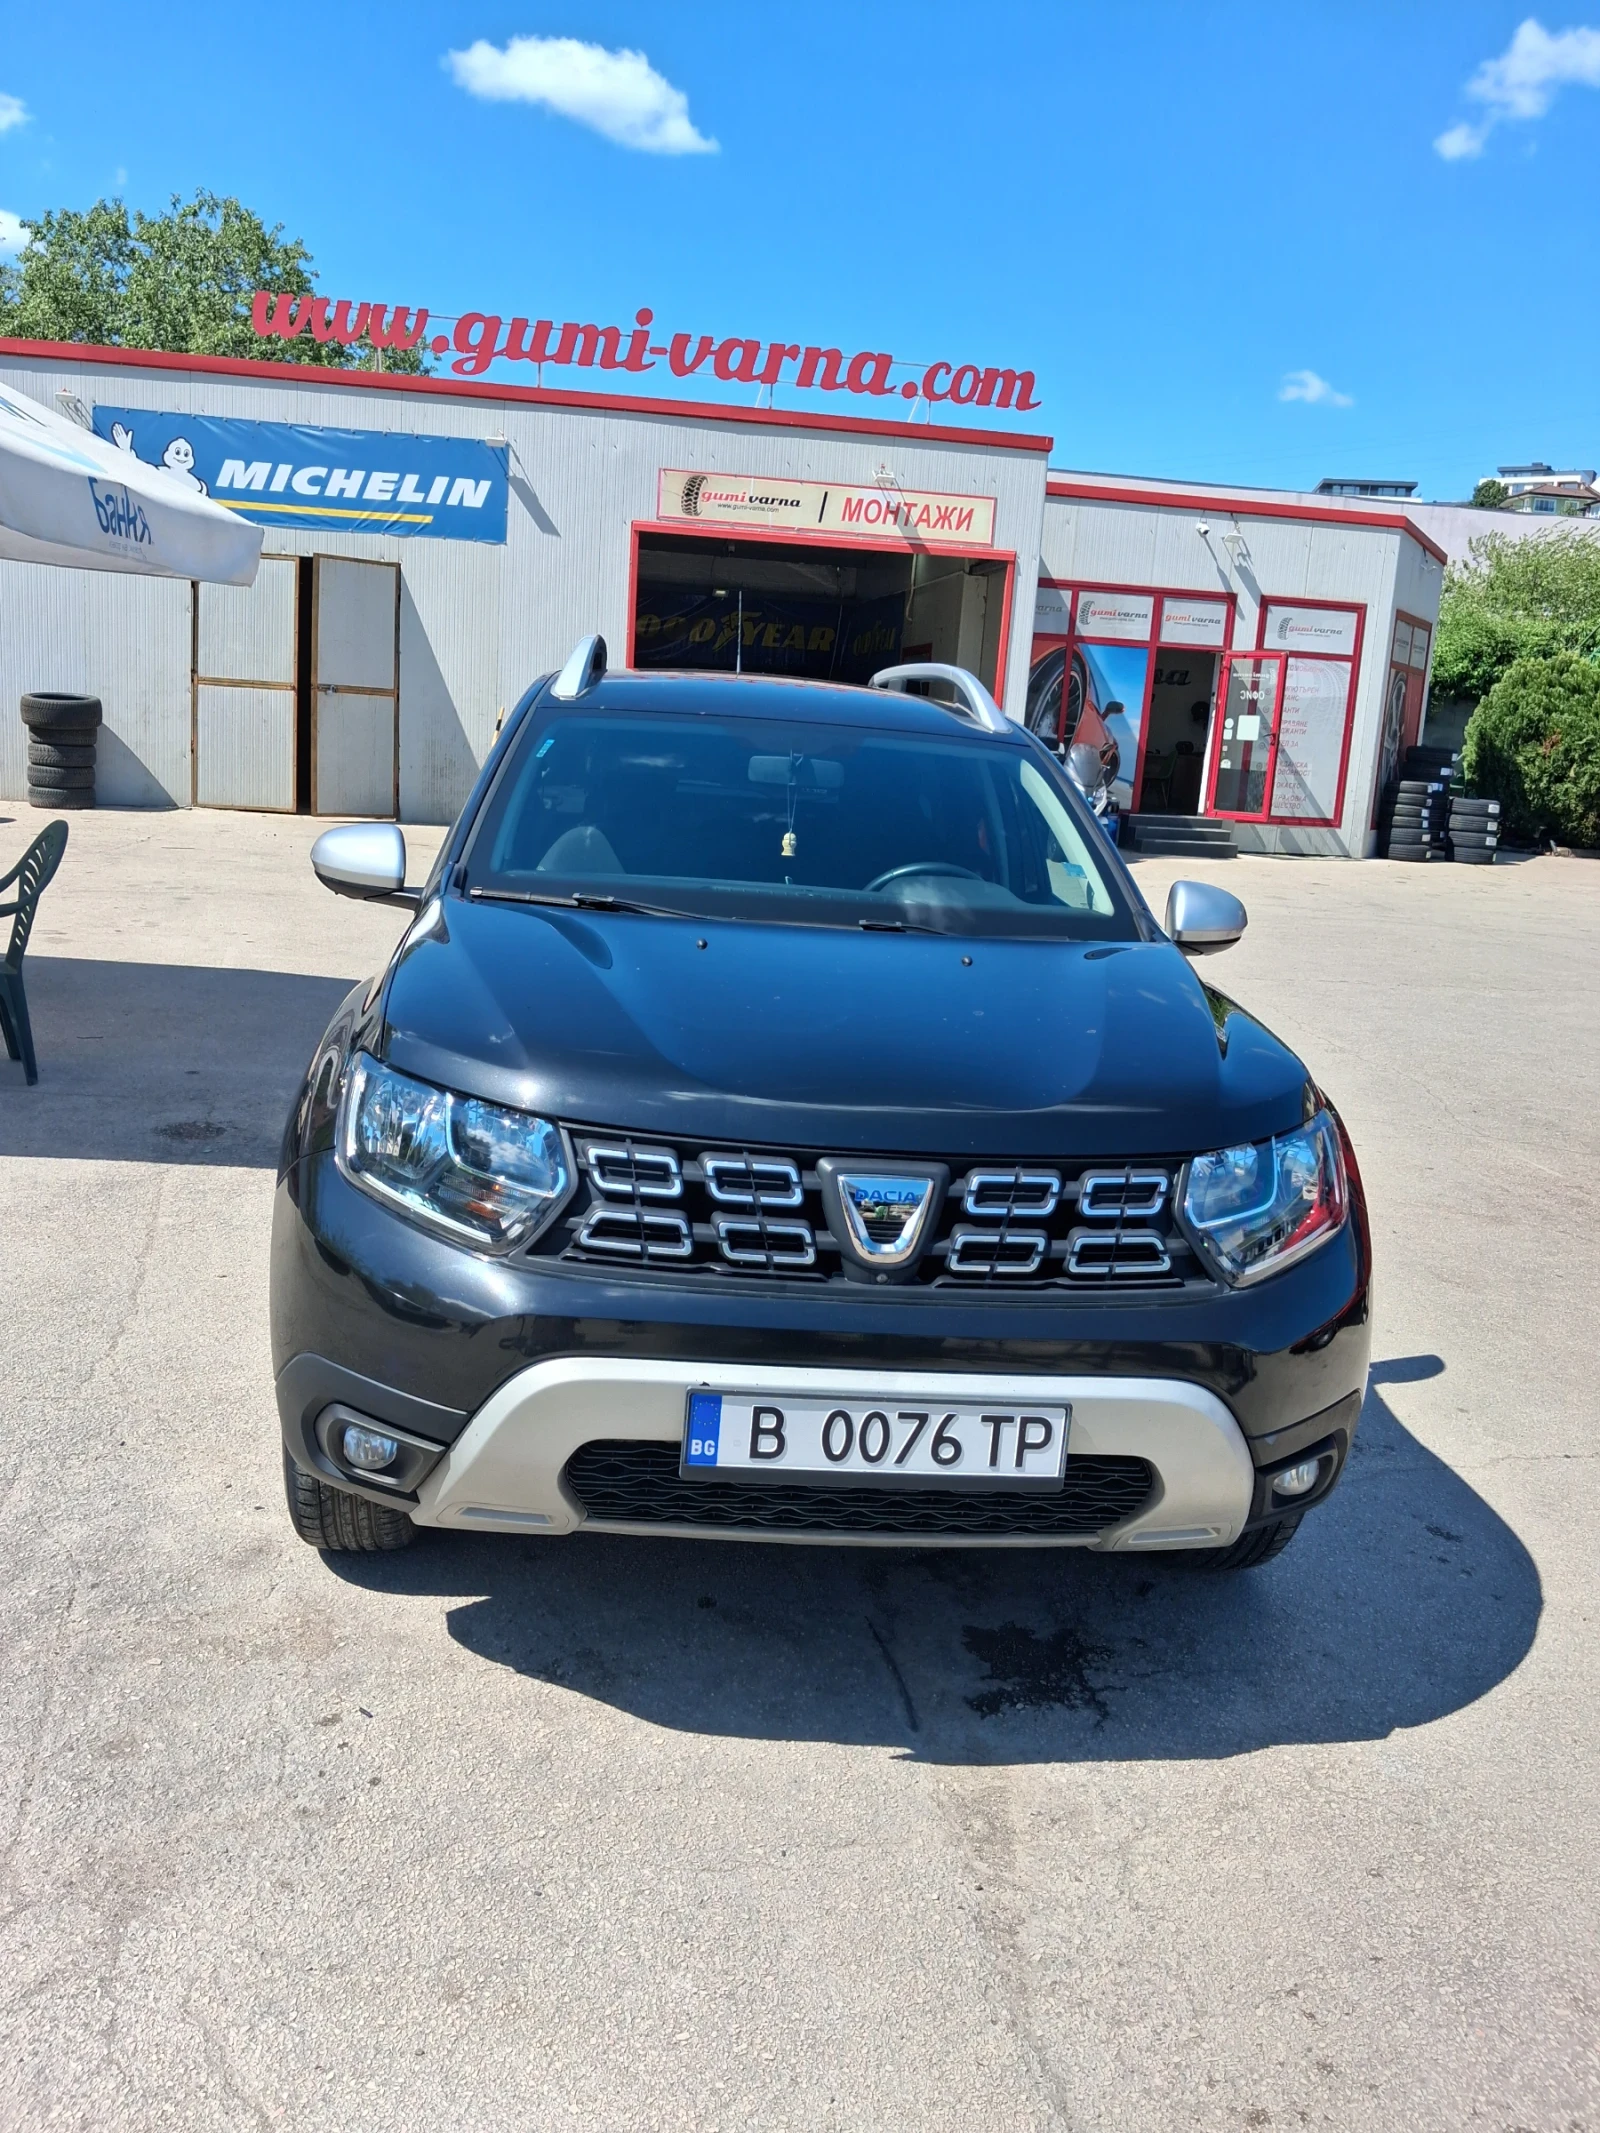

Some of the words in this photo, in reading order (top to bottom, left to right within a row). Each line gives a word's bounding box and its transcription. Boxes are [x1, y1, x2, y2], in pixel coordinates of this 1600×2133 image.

[251, 290, 1042, 411] www.gumi-varna.com
[215, 459, 492, 509] MICHELIN
[701, 491, 746, 503] gumi
[749, 495, 801, 507] varna
[841, 497, 976, 532] МОНТАЖИ
[1090, 609, 1117, 617] gumi
[1117, 611, 1148, 619] varna
[1165, 613, 1191, 622] gumi
[1191, 617, 1221, 625] varna
[1314, 627, 1343, 635] varna
[854, 1189, 917, 1203] DACIA
[748, 1405, 786, 1460] B
[820, 1408, 964, 1466] 0076
[979, 1413, 1053, 1468] TP
[690, 1439, 715, 1456] BG
